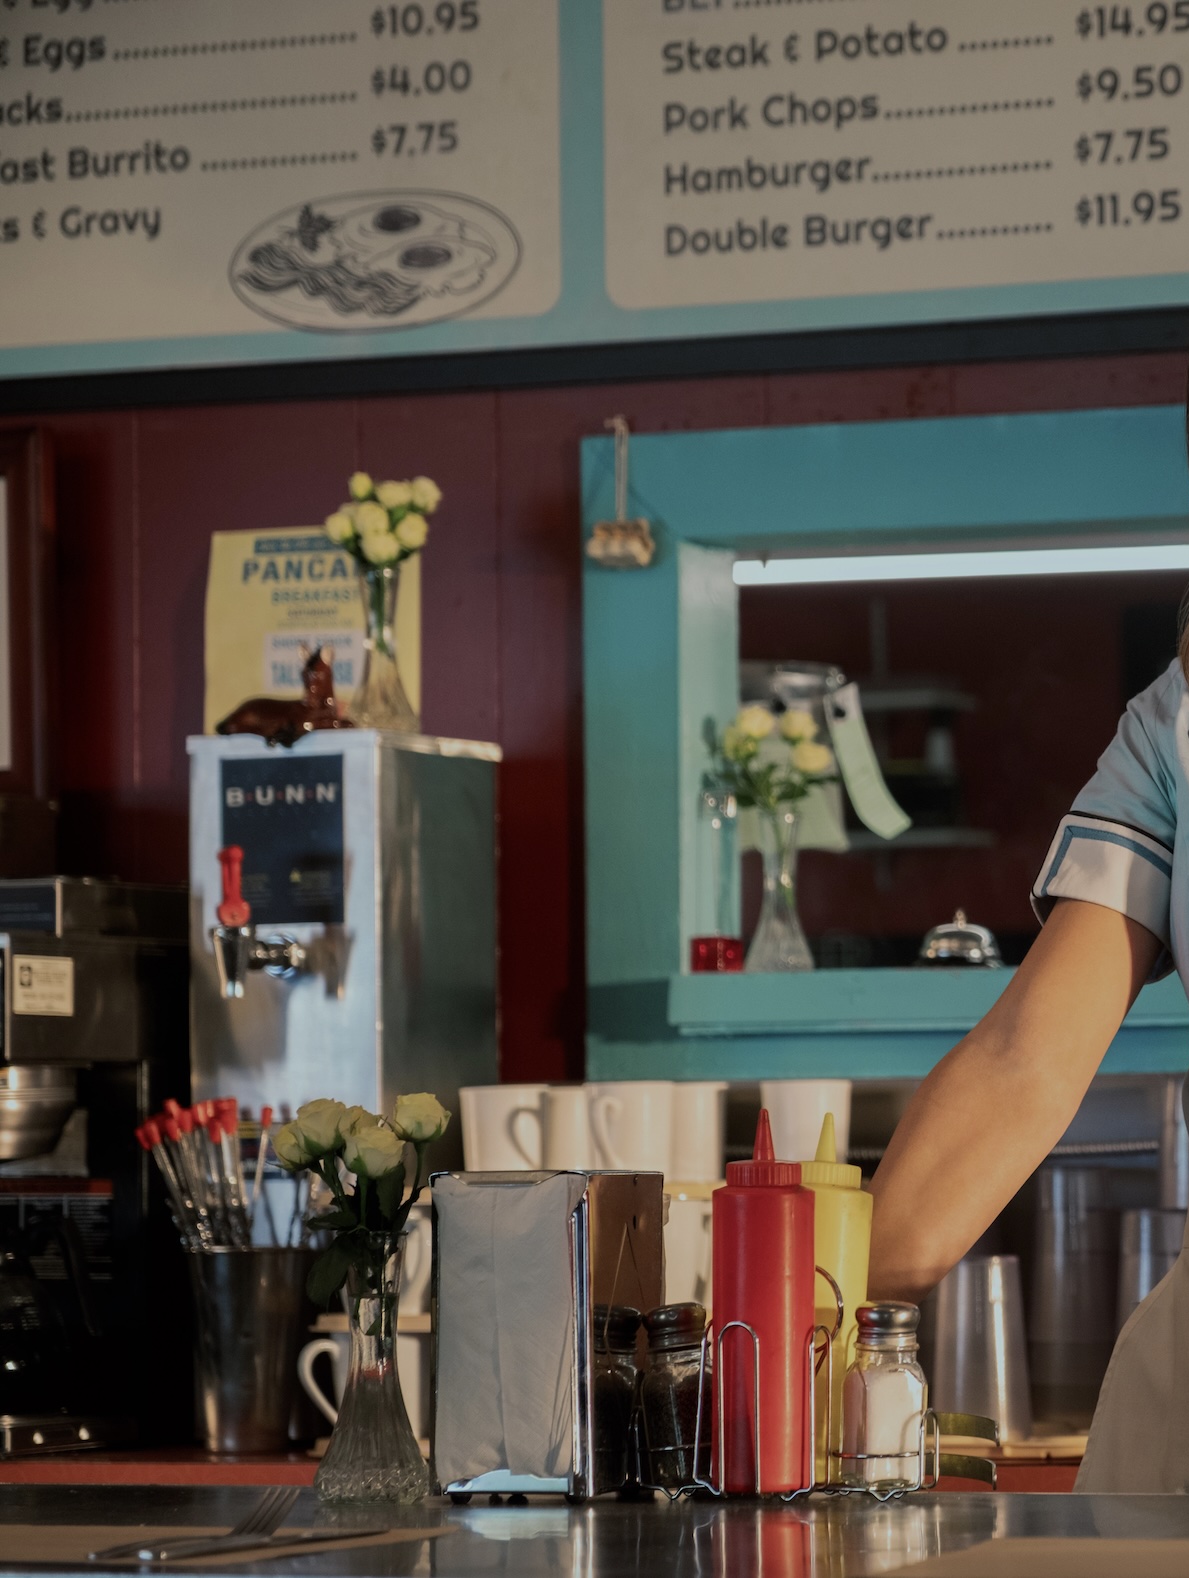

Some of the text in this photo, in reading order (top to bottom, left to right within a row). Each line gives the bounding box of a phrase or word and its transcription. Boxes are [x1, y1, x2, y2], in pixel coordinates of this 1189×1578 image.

[24, 34, 106, 72] Eggs
[371, 0, 479, 38] $10.95
[662, 38, 769, 75] Steak
[815, 21, 948, 62] Potato
[0, 59, 472, 126] cks $4.00
[664, 64, 1183, 133] Pork Chops $9.50
[68, 140, 190, 181] Burrito
[371, 119, 458, 156] $7.75
[664, 127, 1170, 195] Hamburger $7.75
[60, 205, 162, 242] Gravy
[665, 189, 1181, 257] Double Burger $11.95
[226, 782, 337, 808] BUNN
